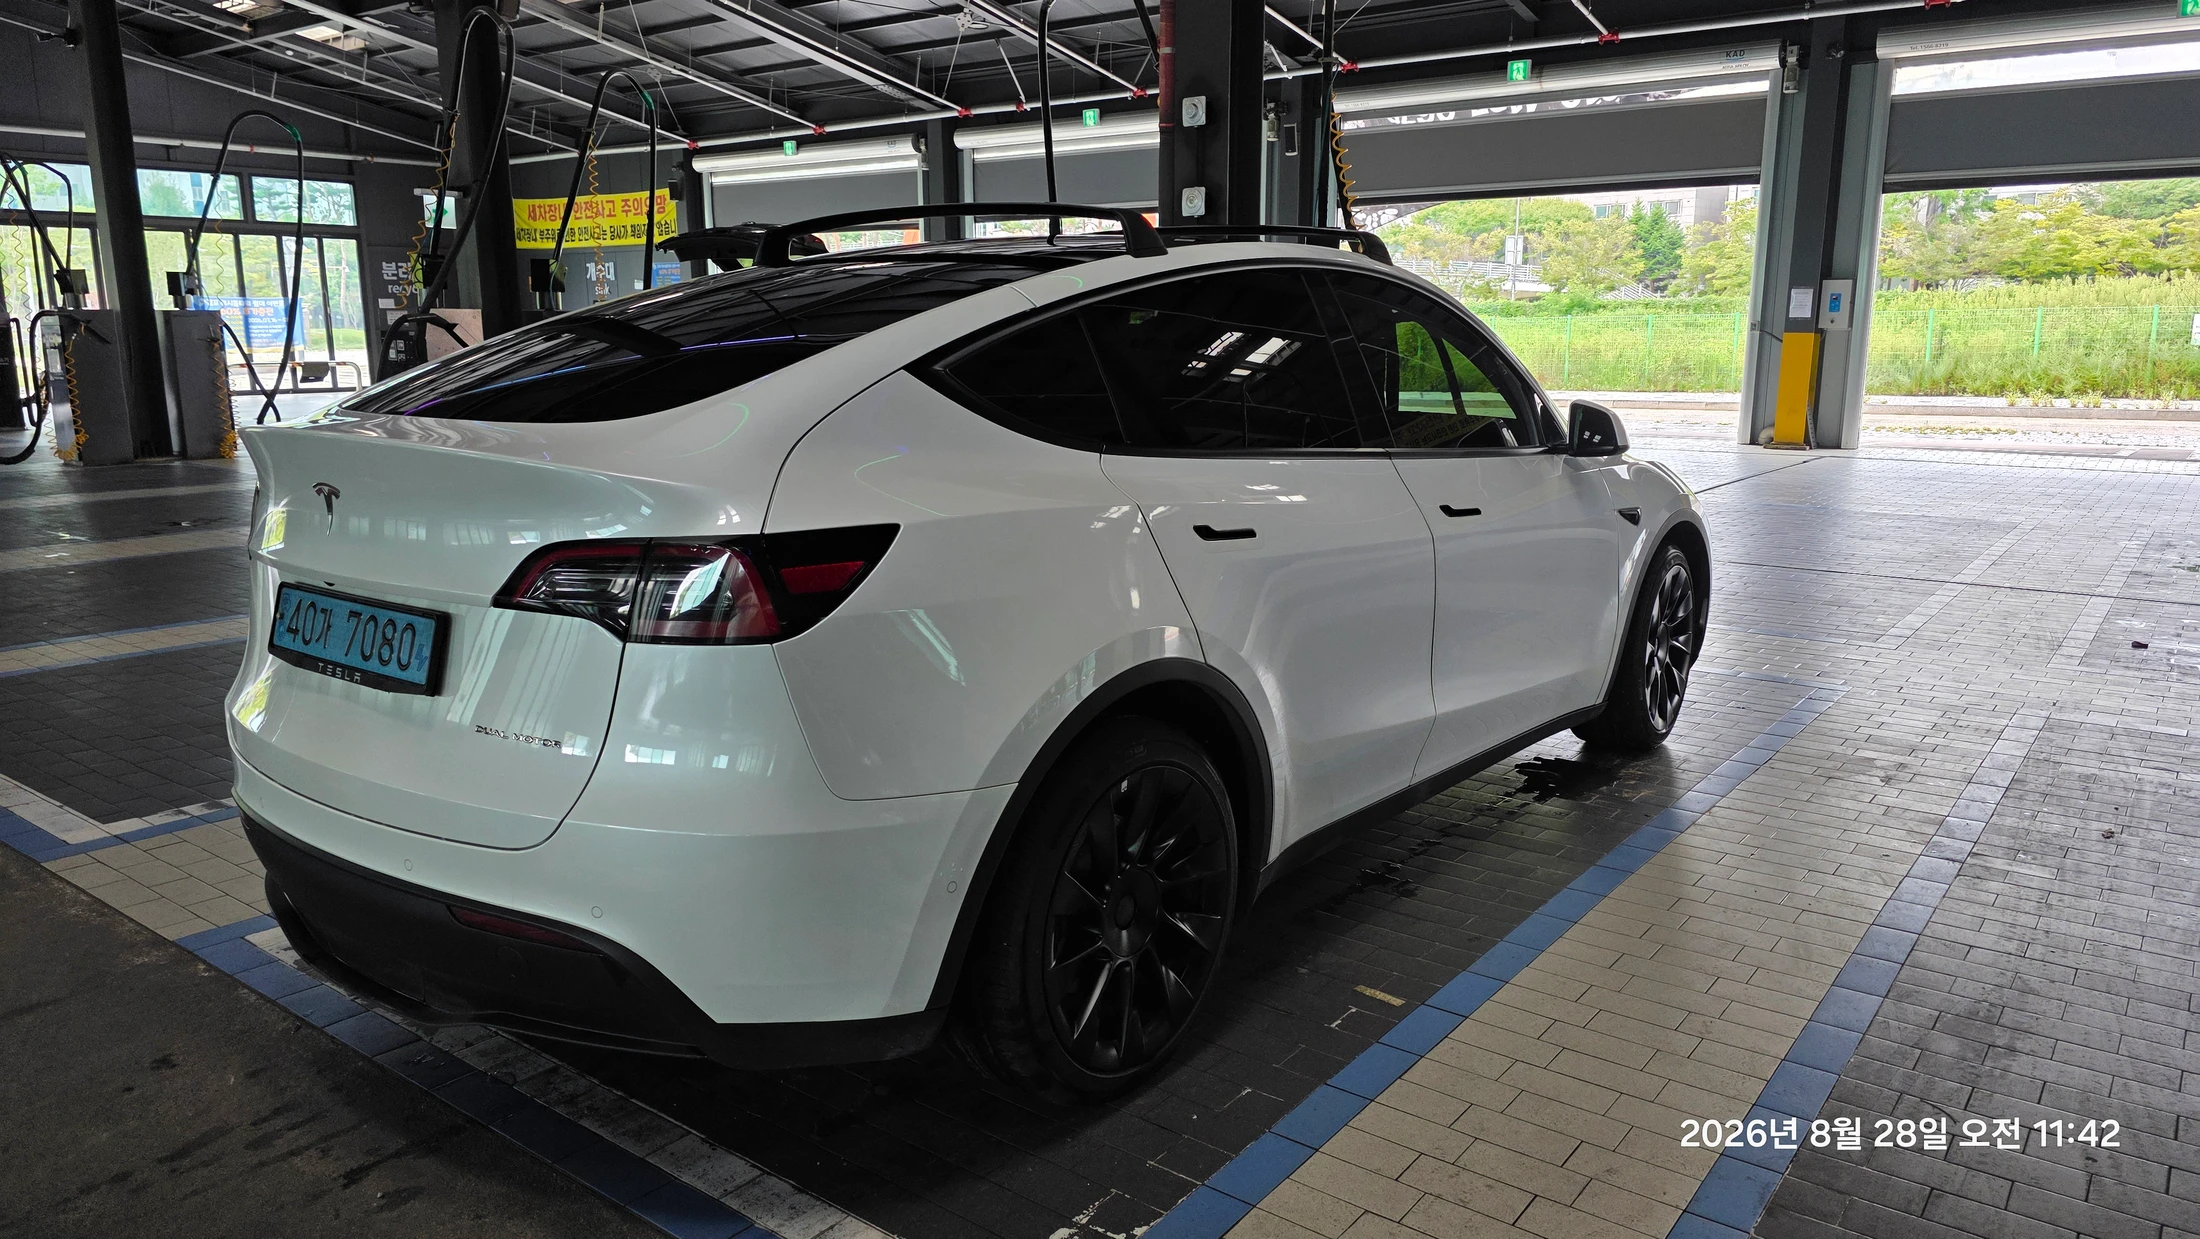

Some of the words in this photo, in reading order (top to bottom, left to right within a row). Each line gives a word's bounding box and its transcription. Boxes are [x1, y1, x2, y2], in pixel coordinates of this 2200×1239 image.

[1725, 49, 1746, 58] KAD
[609, 223, 629, 241] 당사가
[630, 222, 649, 239] 책임지
[286, 598, 333, 649] 40가
[344, 609, 417, 672] 7080
[318, 662, 361, 684] TESLA
[475, 724, 509, 740] DUAL
[512, 732, 562, 748] MOTOR
